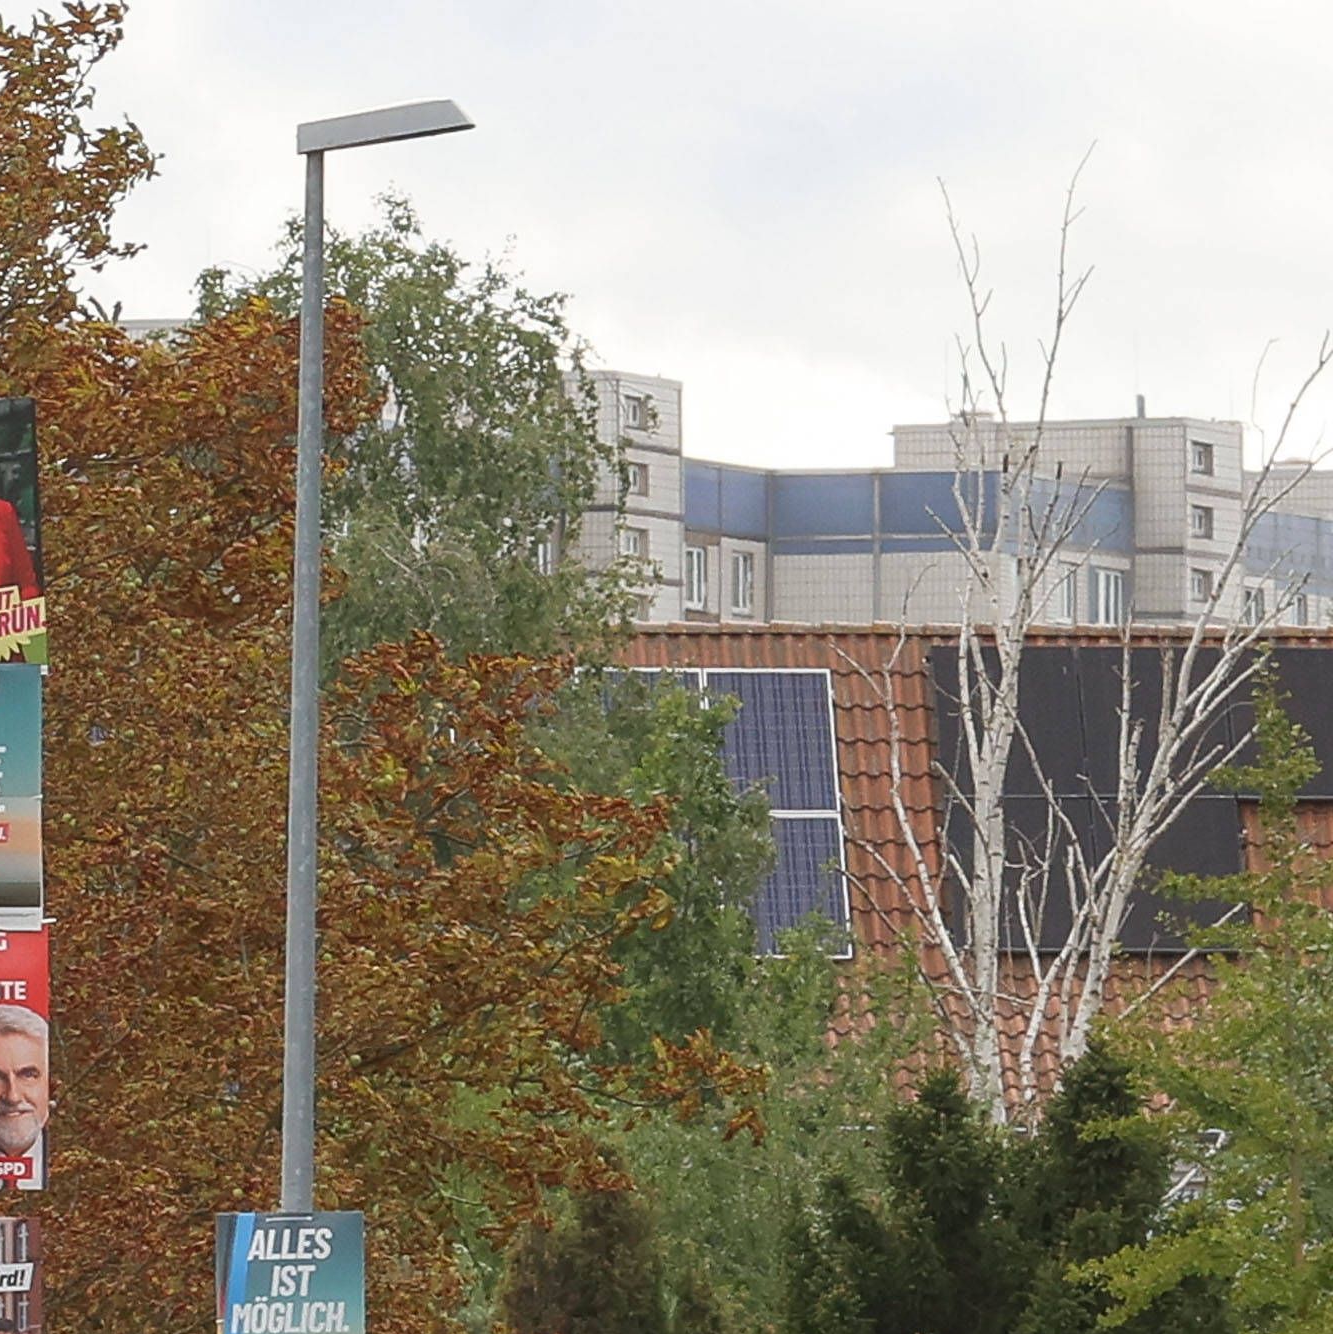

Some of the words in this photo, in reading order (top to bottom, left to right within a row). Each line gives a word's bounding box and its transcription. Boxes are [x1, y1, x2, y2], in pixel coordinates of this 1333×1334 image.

[247, 1227, 333, 1262] ALLES
[269, 1265, 316, 1297] IST
[230, 1297, 350, 1334] MÖGLICH.
